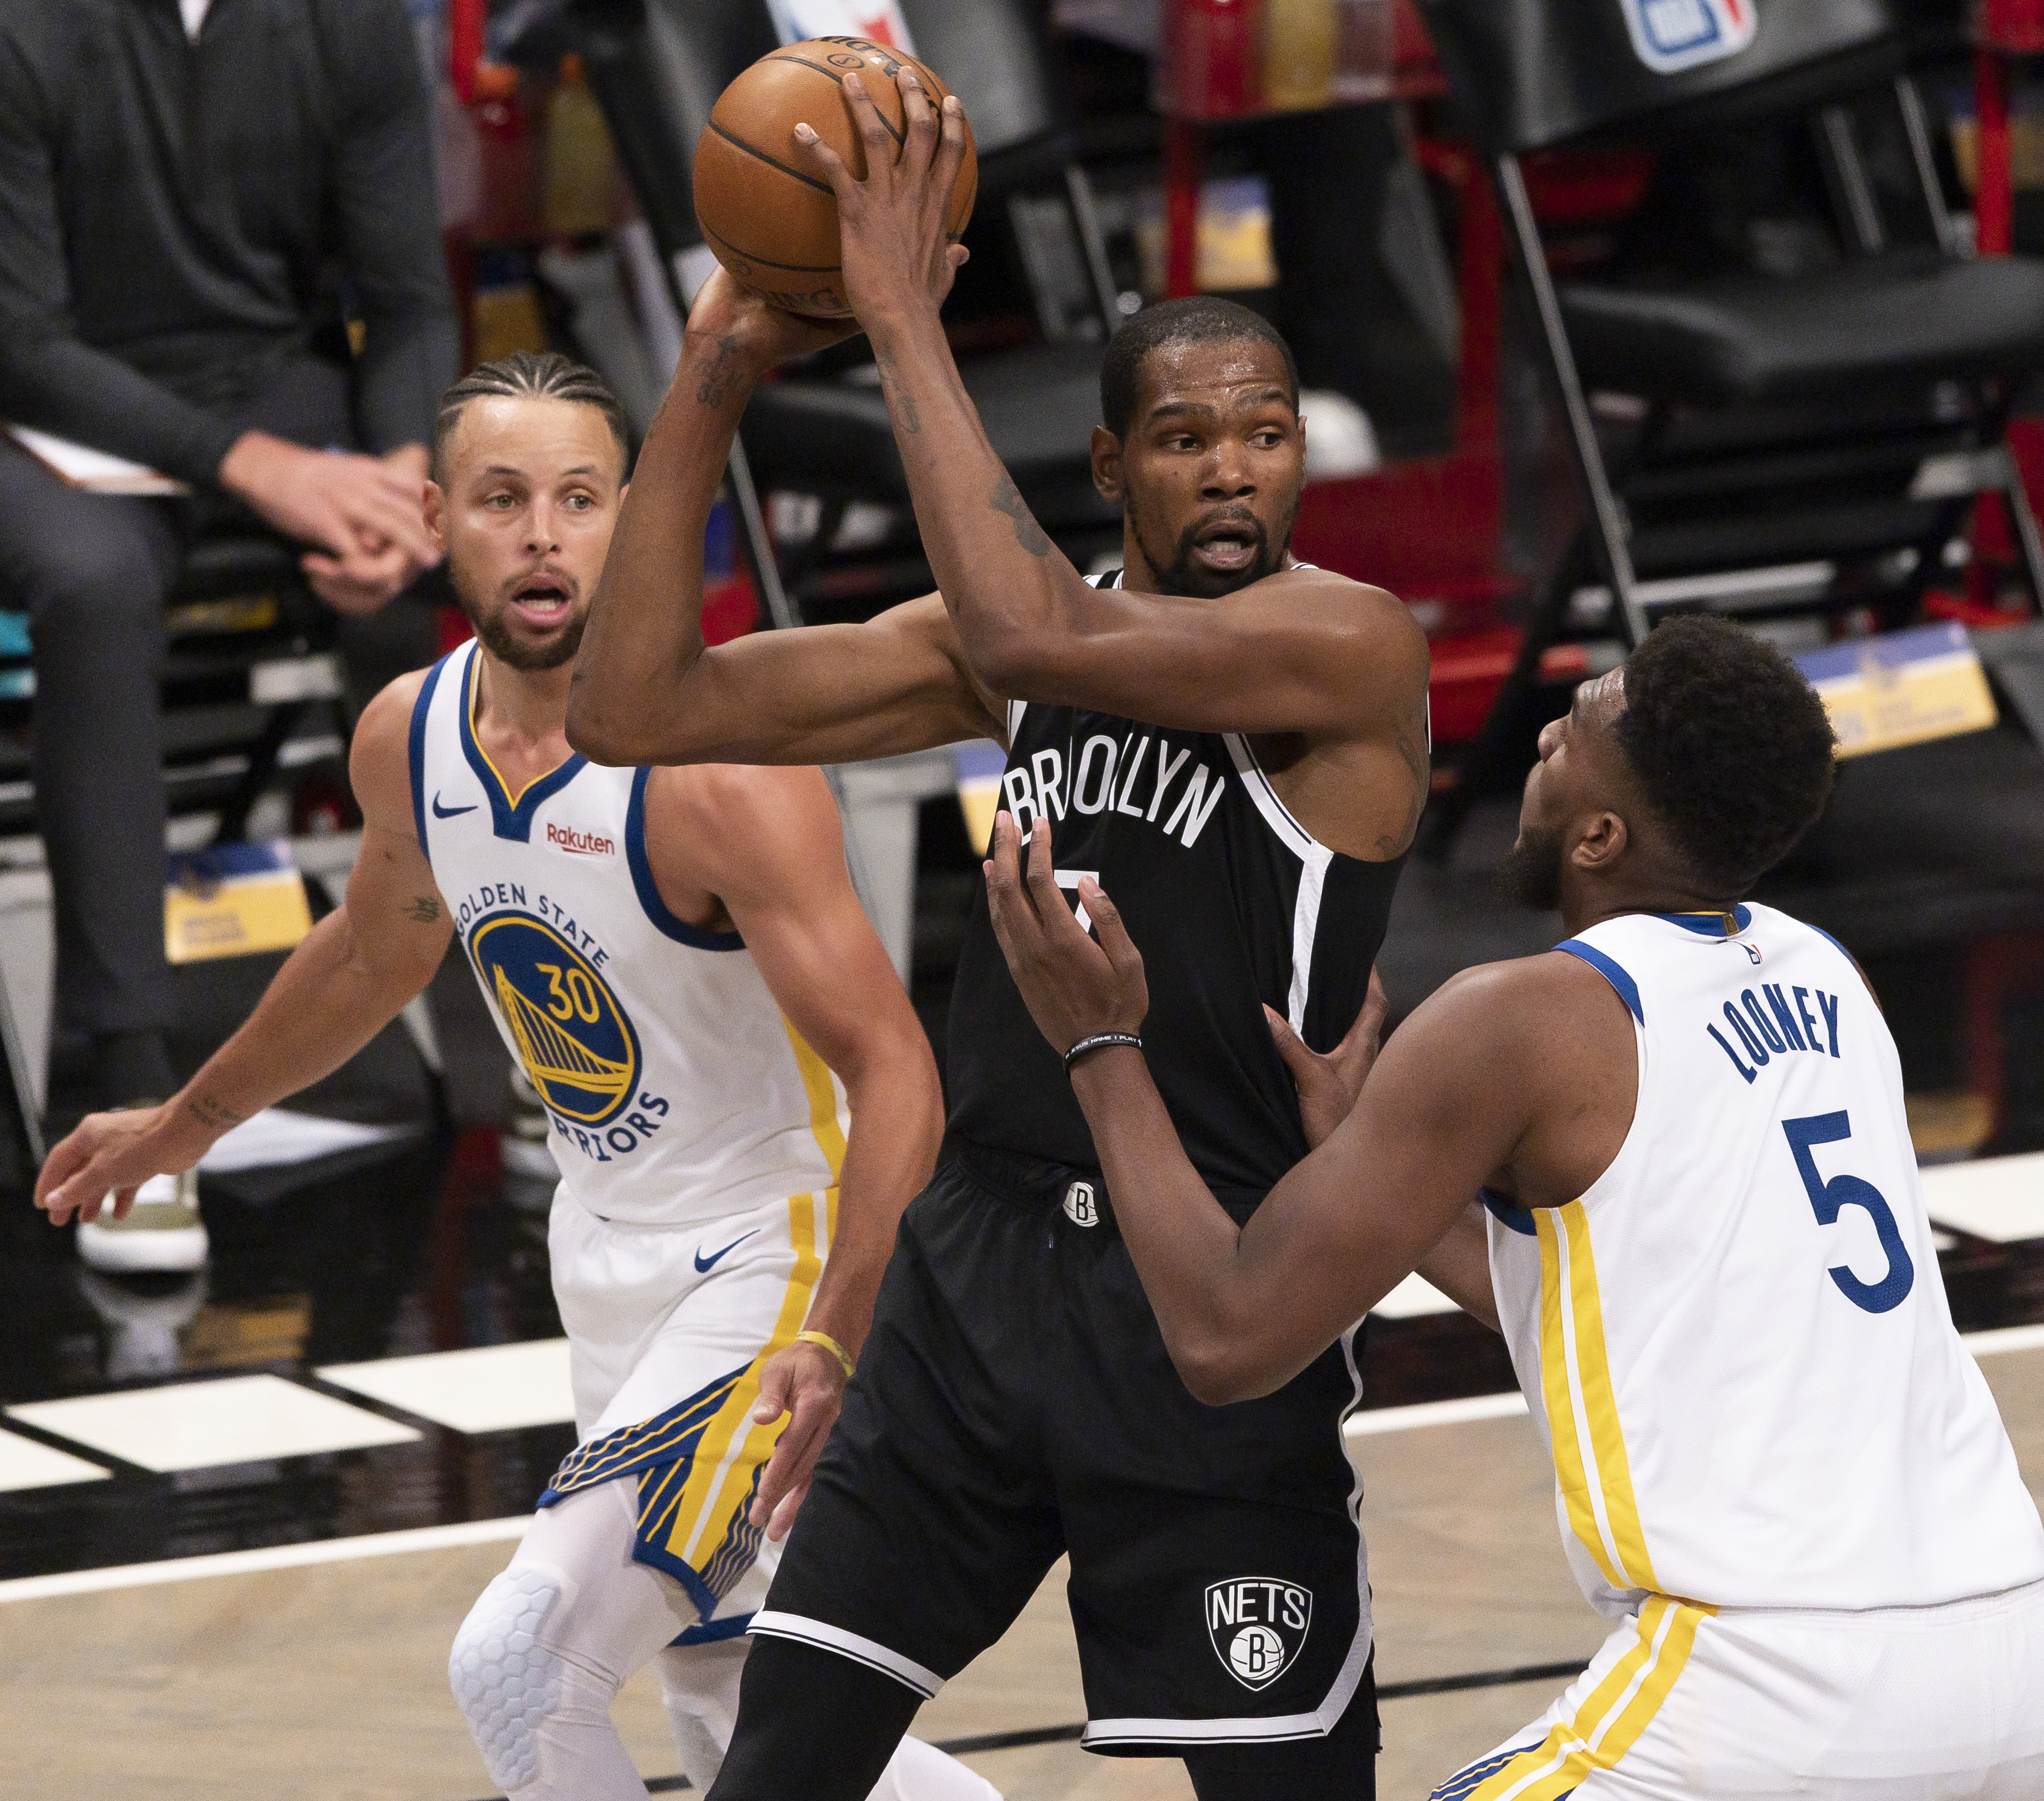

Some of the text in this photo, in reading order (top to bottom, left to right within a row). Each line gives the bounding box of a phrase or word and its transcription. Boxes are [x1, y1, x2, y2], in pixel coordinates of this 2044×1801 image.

[1003, 733, 1225, 848] BROLYN
[547, 822, 615, 855] Rakuten
[455, 883, 526, 937] GOLDEN
[539, 894, 609, 969] STATE
[535, 962, 600, 1024] 30
[1071, 1040, 1089, 1054] JESUS
[1091, 1035, 1112, 1044] NAME
[1707, 983, 1840, 1084] LOONEY
[553, 1092, 669, 1162] RRIORS
[1076, 1188, 1089, 1221] B
[1782, 1110, 1914, 1314] 5
[1213, 1582, 1305, 1630] NETS
[1249, 1634, 1266, 1672] B
